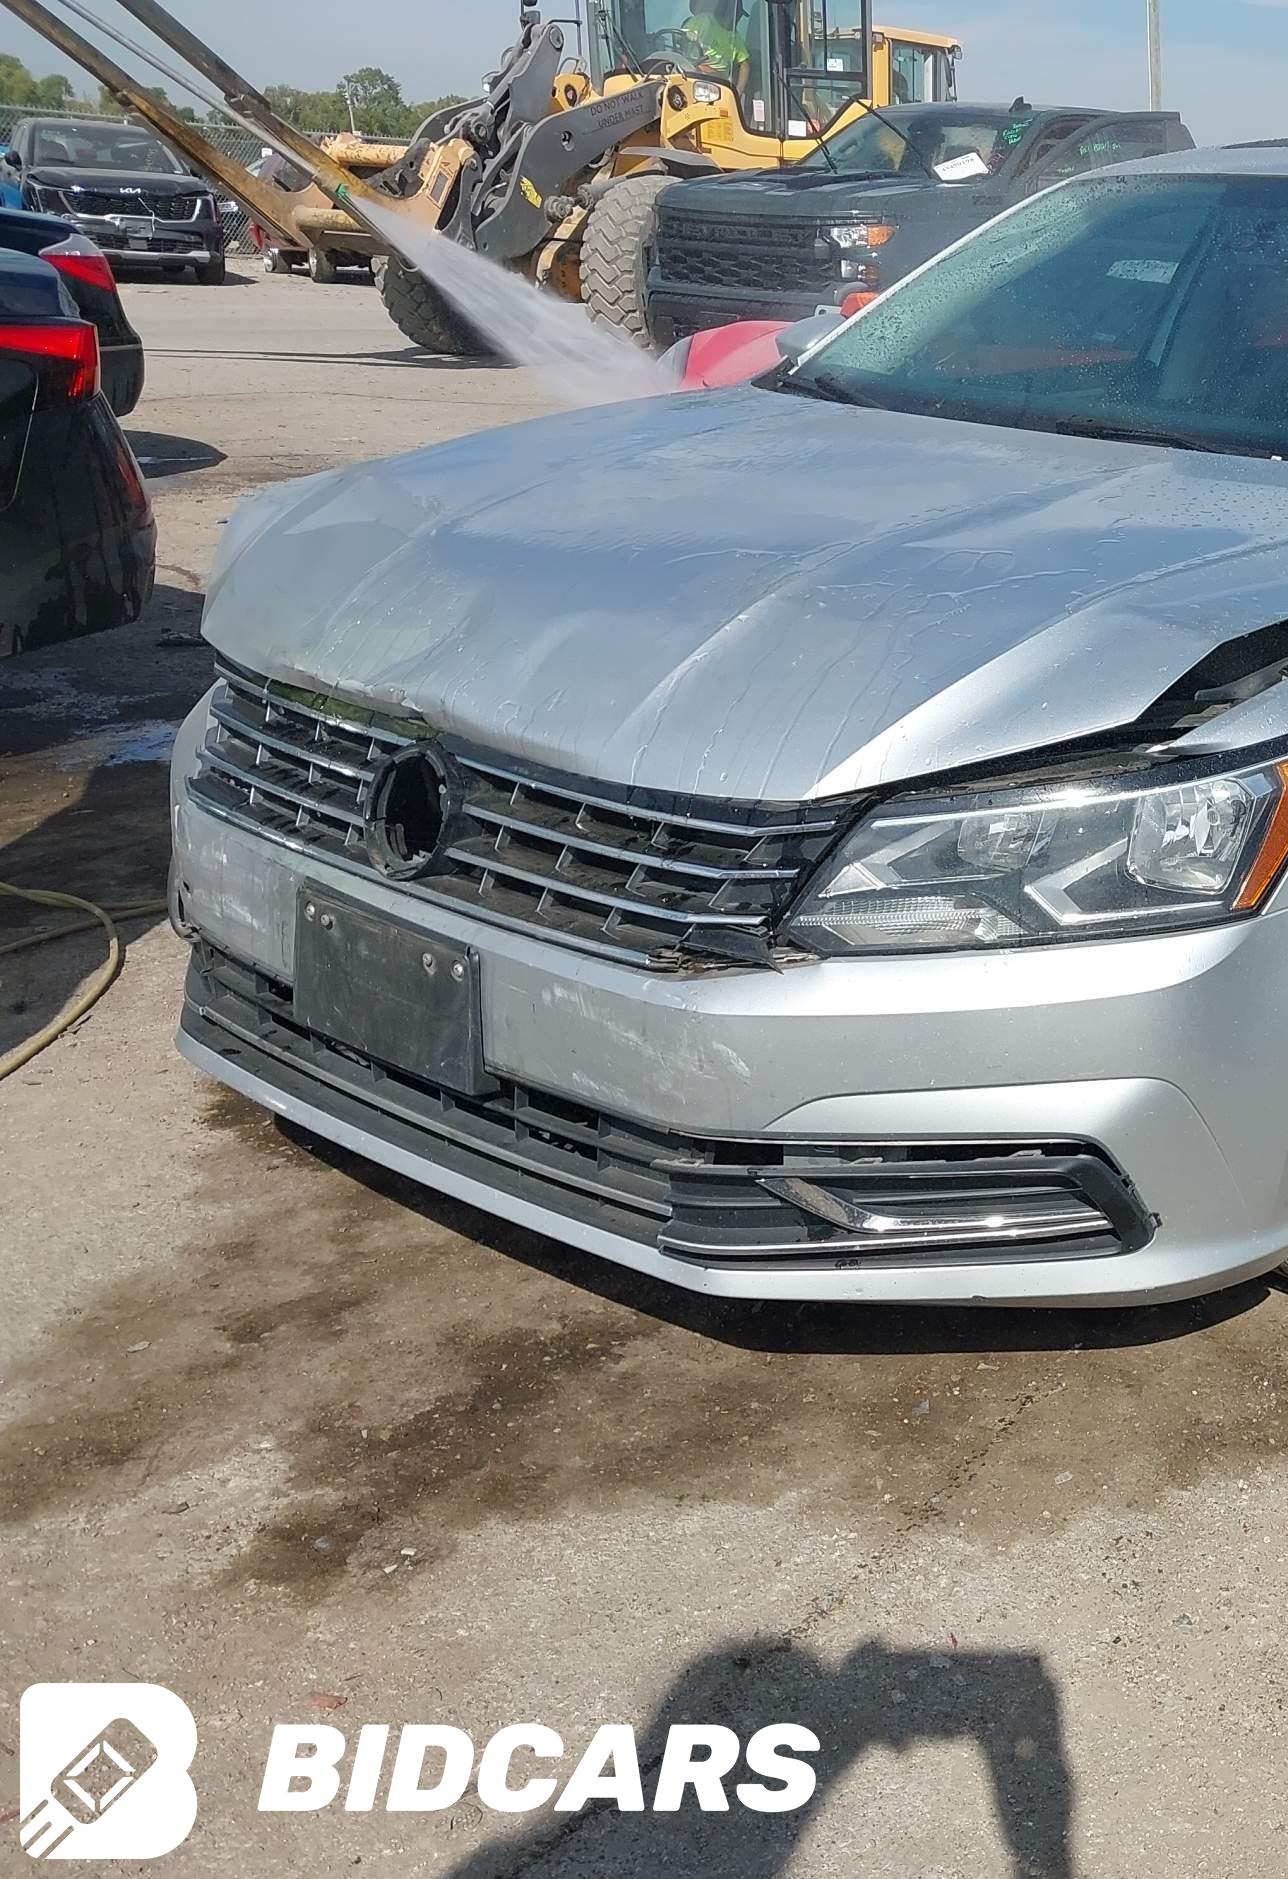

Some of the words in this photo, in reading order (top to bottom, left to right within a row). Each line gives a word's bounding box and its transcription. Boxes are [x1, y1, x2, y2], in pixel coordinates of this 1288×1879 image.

[590, 104, 603, 117] DO
[604, 98, 621, 111] NOT
[621, 91, 644, 105] WALK
[598, 111, 625, 129] UNDER
